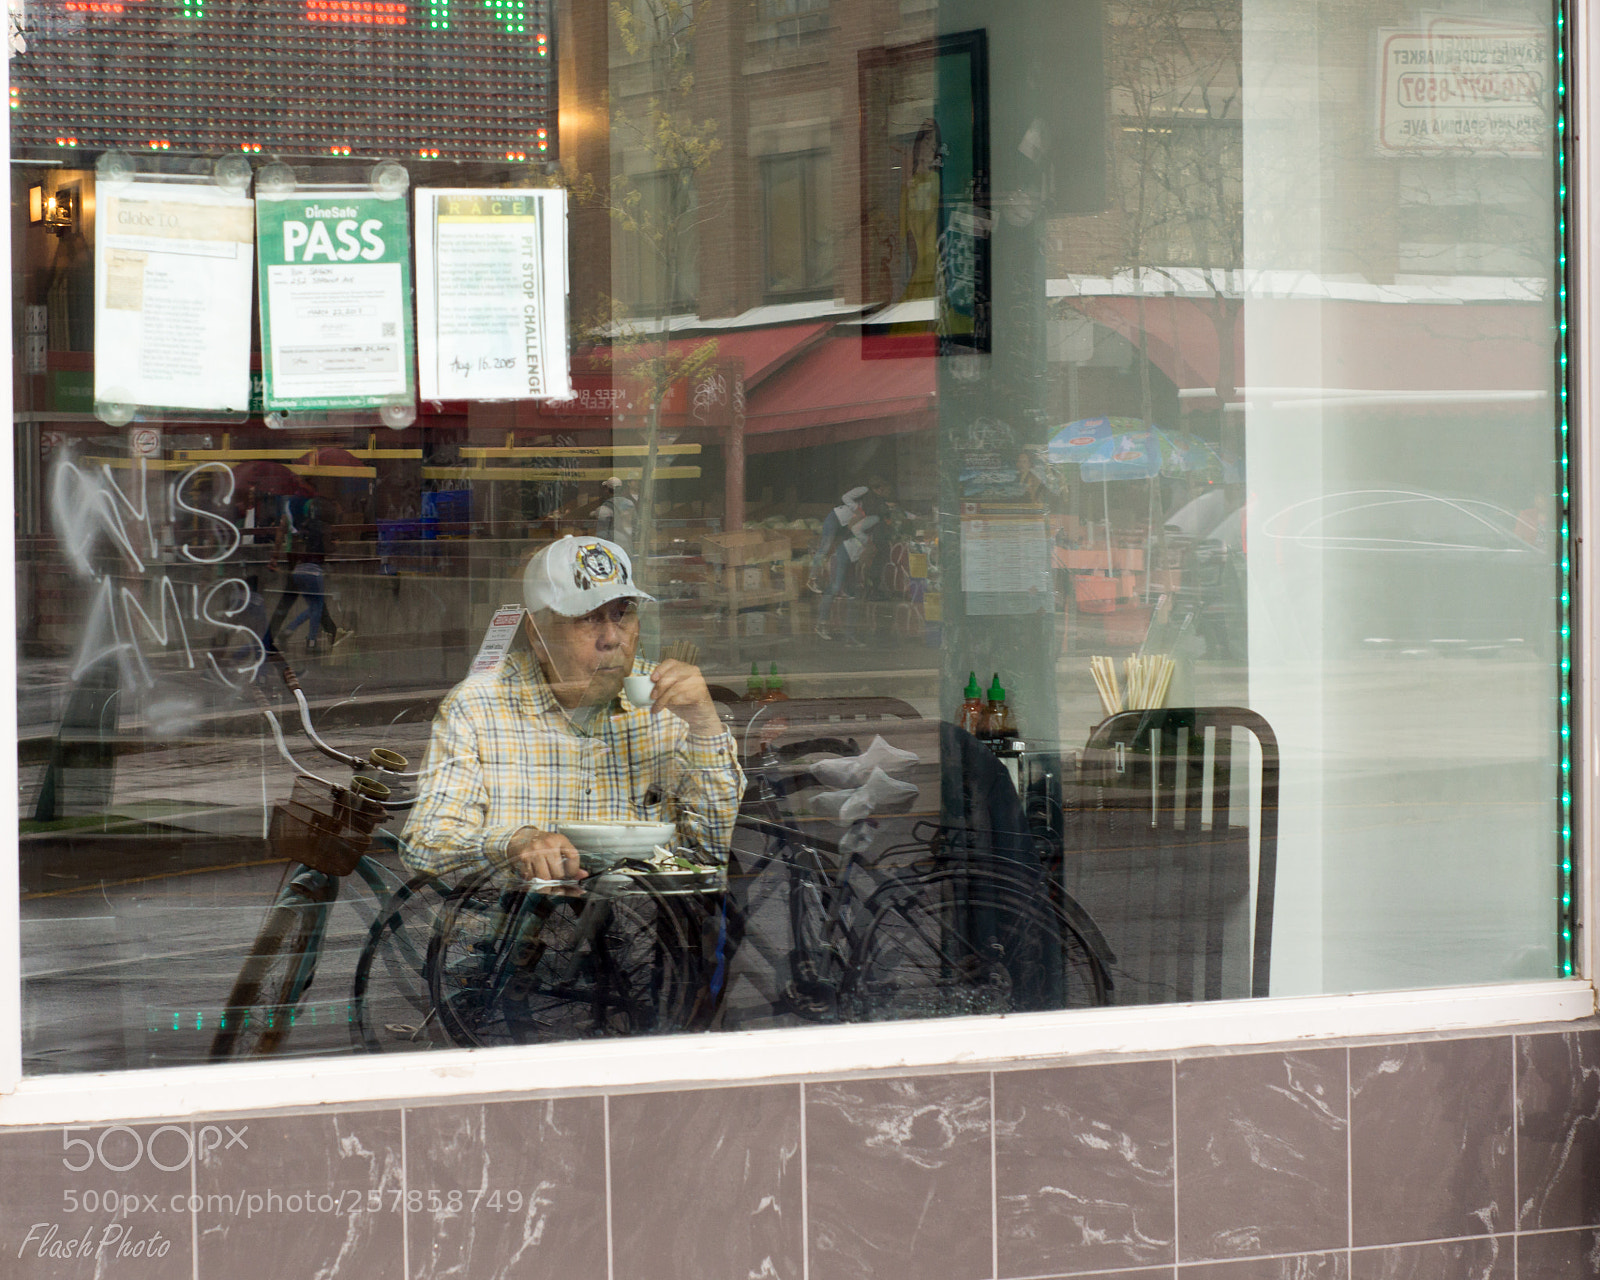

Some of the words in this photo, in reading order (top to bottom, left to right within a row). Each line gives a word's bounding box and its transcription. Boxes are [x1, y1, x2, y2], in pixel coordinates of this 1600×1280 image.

[117, 210, 154, 227] Globe
[305, 205, 358, 219] DineSafe
[450, 202, 525, 215] RACE
[283, 219, 386, 262] PASS
[522, 236, 533, 258] PIT
[522, 263, 535, 299] STOP
[524, 305, 541, 395] CHALLENGE
